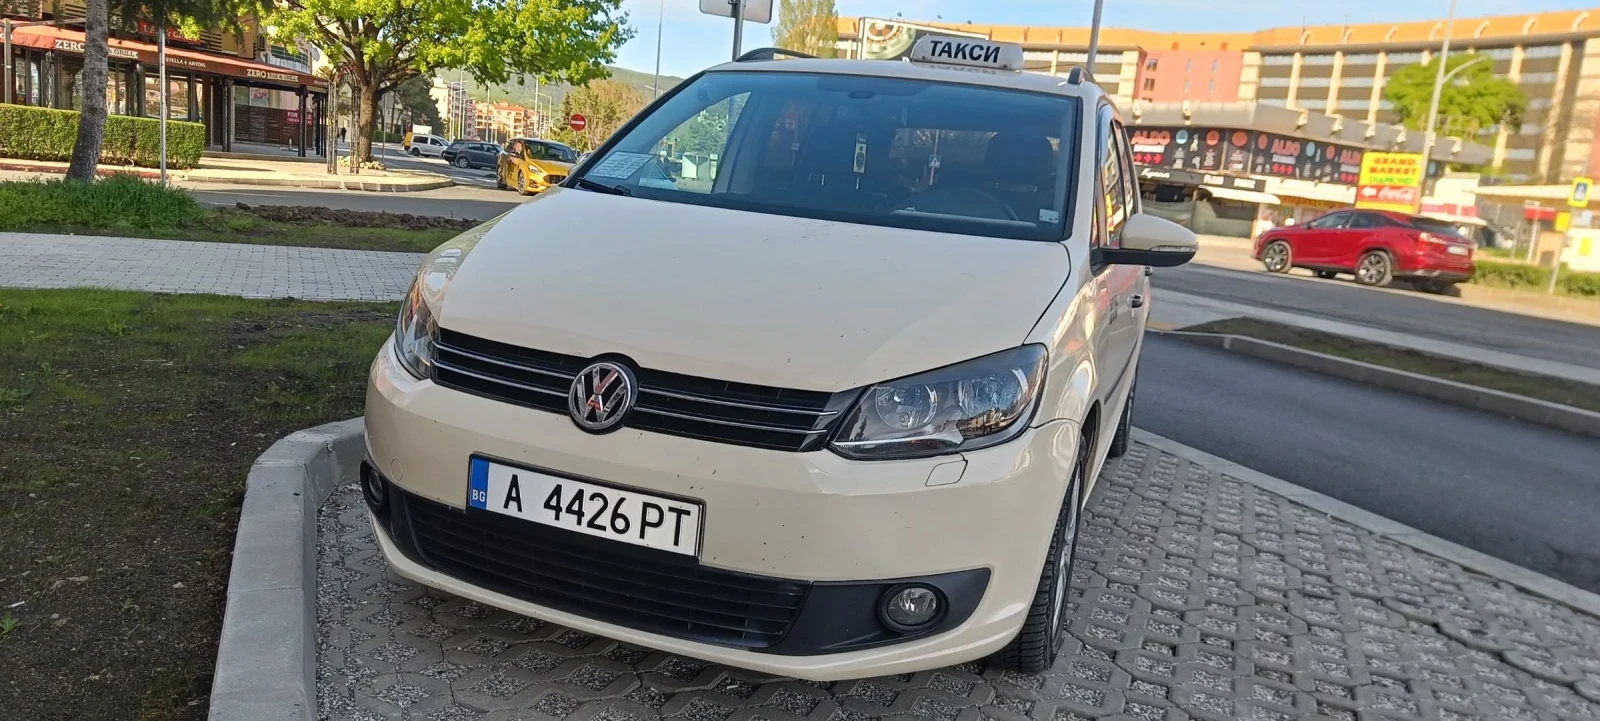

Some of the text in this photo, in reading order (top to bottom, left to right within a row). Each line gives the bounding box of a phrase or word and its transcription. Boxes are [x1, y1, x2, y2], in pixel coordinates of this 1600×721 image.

[114, 49, 135, 57] GRILL
[930, 40, 1000, 63] ТАКСИ
[165, 57, 184, 65] STELLA
[246, 69, 266, 78] ZERO
[1131, 130, 1171, 145] ALDO
[1271, 138, 1300, 157] ALDO
[1369, 167, 1417, 175] MARKET
[472, 489, 486, 502] BG
[503, 473, 692, 547] A 4426 PT
